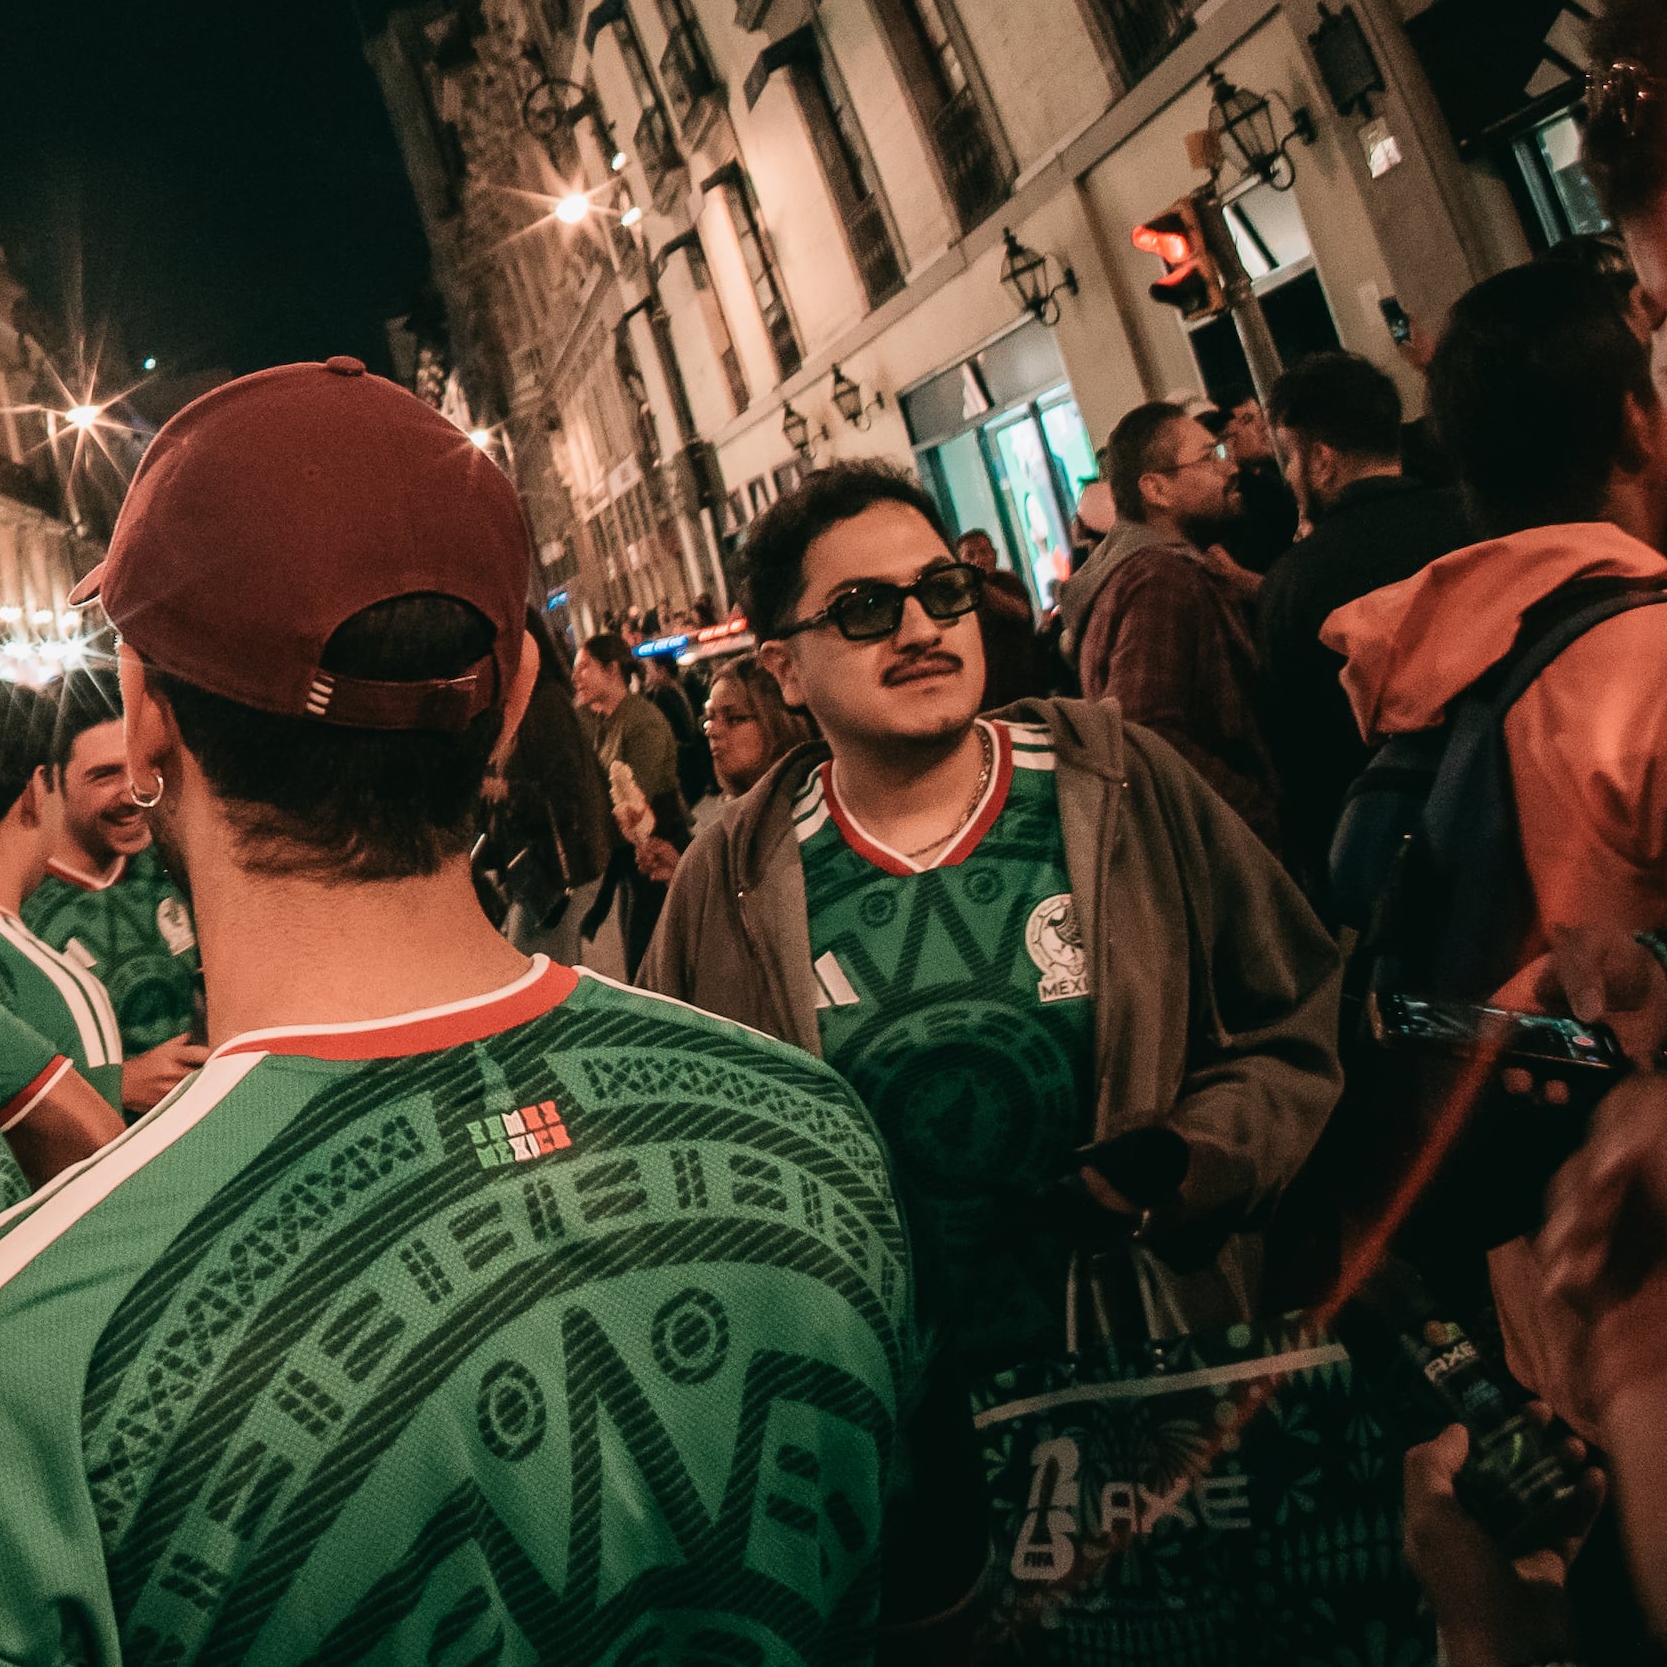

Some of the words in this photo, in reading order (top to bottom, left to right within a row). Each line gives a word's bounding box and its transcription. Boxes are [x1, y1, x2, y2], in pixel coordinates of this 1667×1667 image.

[1041, 977, 1089, 999] MÉXI
[1424, 1341, 1477, 1382] AXE
[1101, 1474, 1251, 1534] AXE
[1024, 1551, 1054, 1568] FIFA
